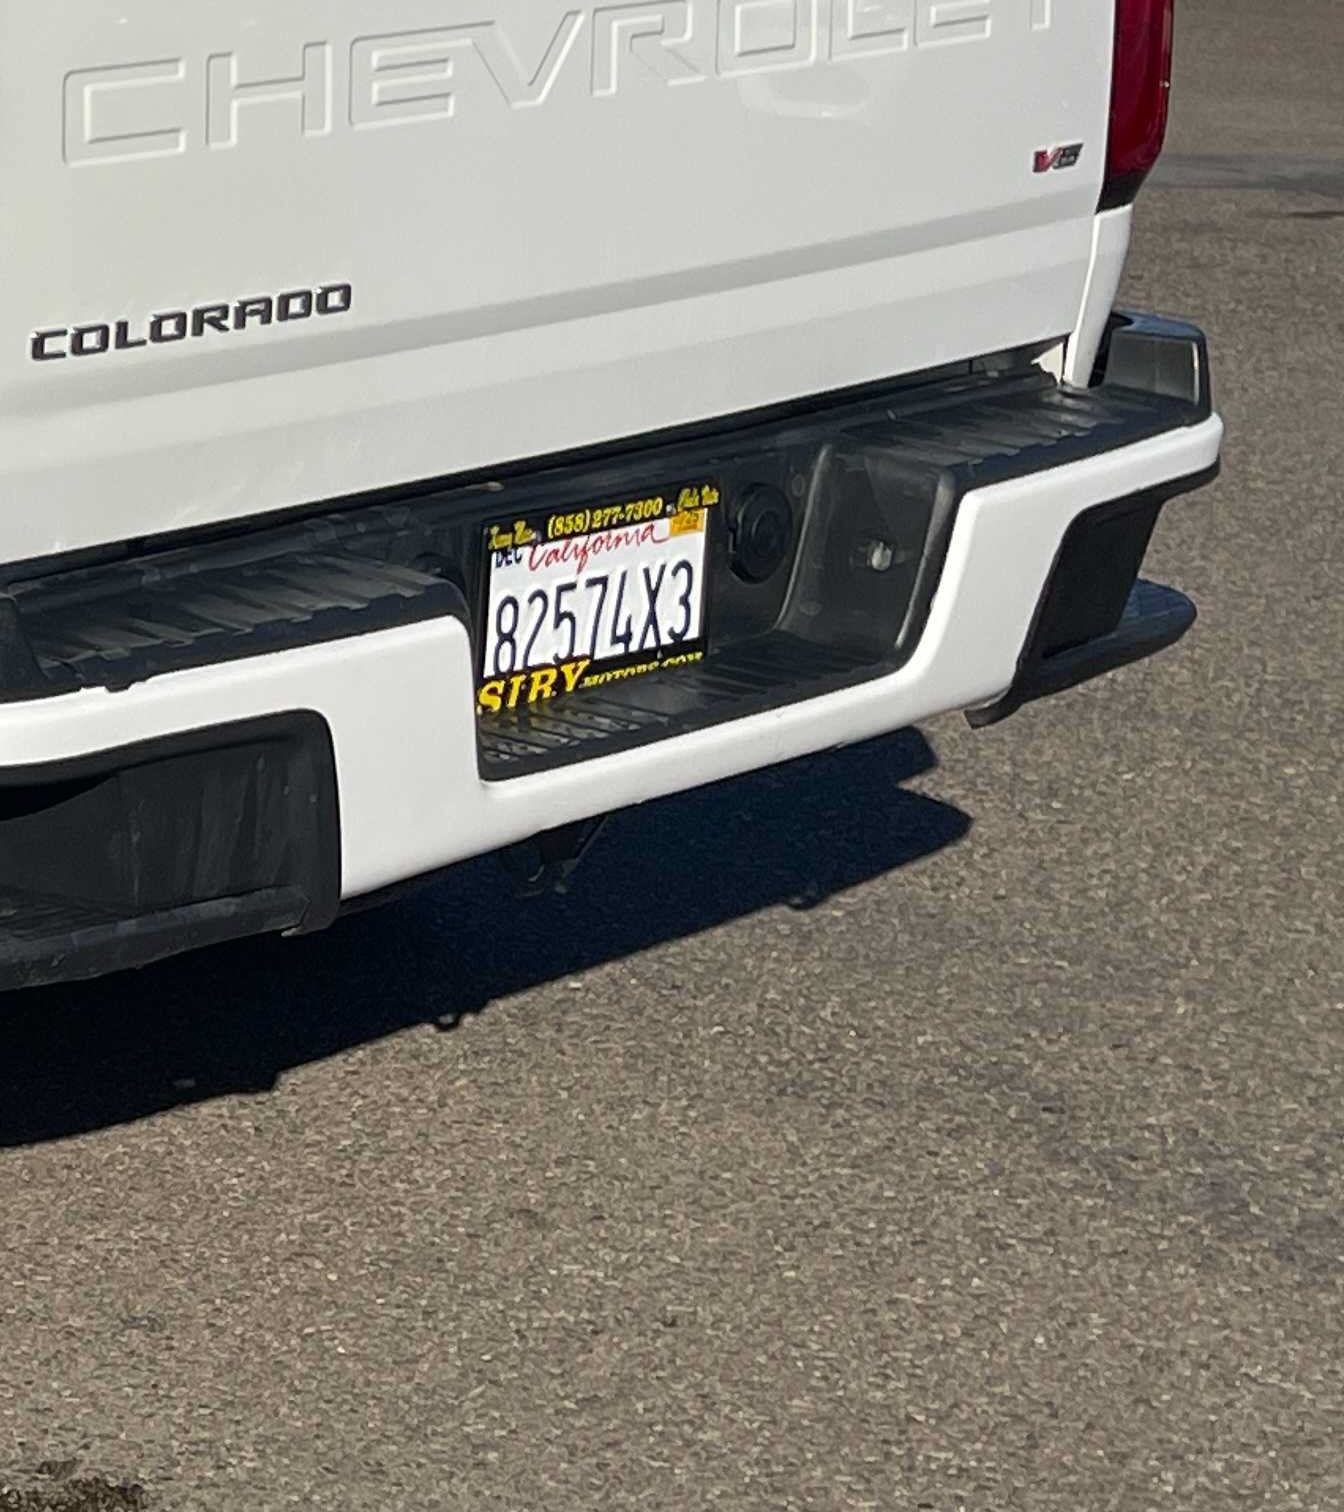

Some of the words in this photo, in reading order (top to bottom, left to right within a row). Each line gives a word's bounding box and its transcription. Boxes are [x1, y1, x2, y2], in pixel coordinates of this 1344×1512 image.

[31, 283, 352, 361] COLORADO
[493, 559, 694, 676] 82574X3
[477, 657, 591, 715] SIRY
